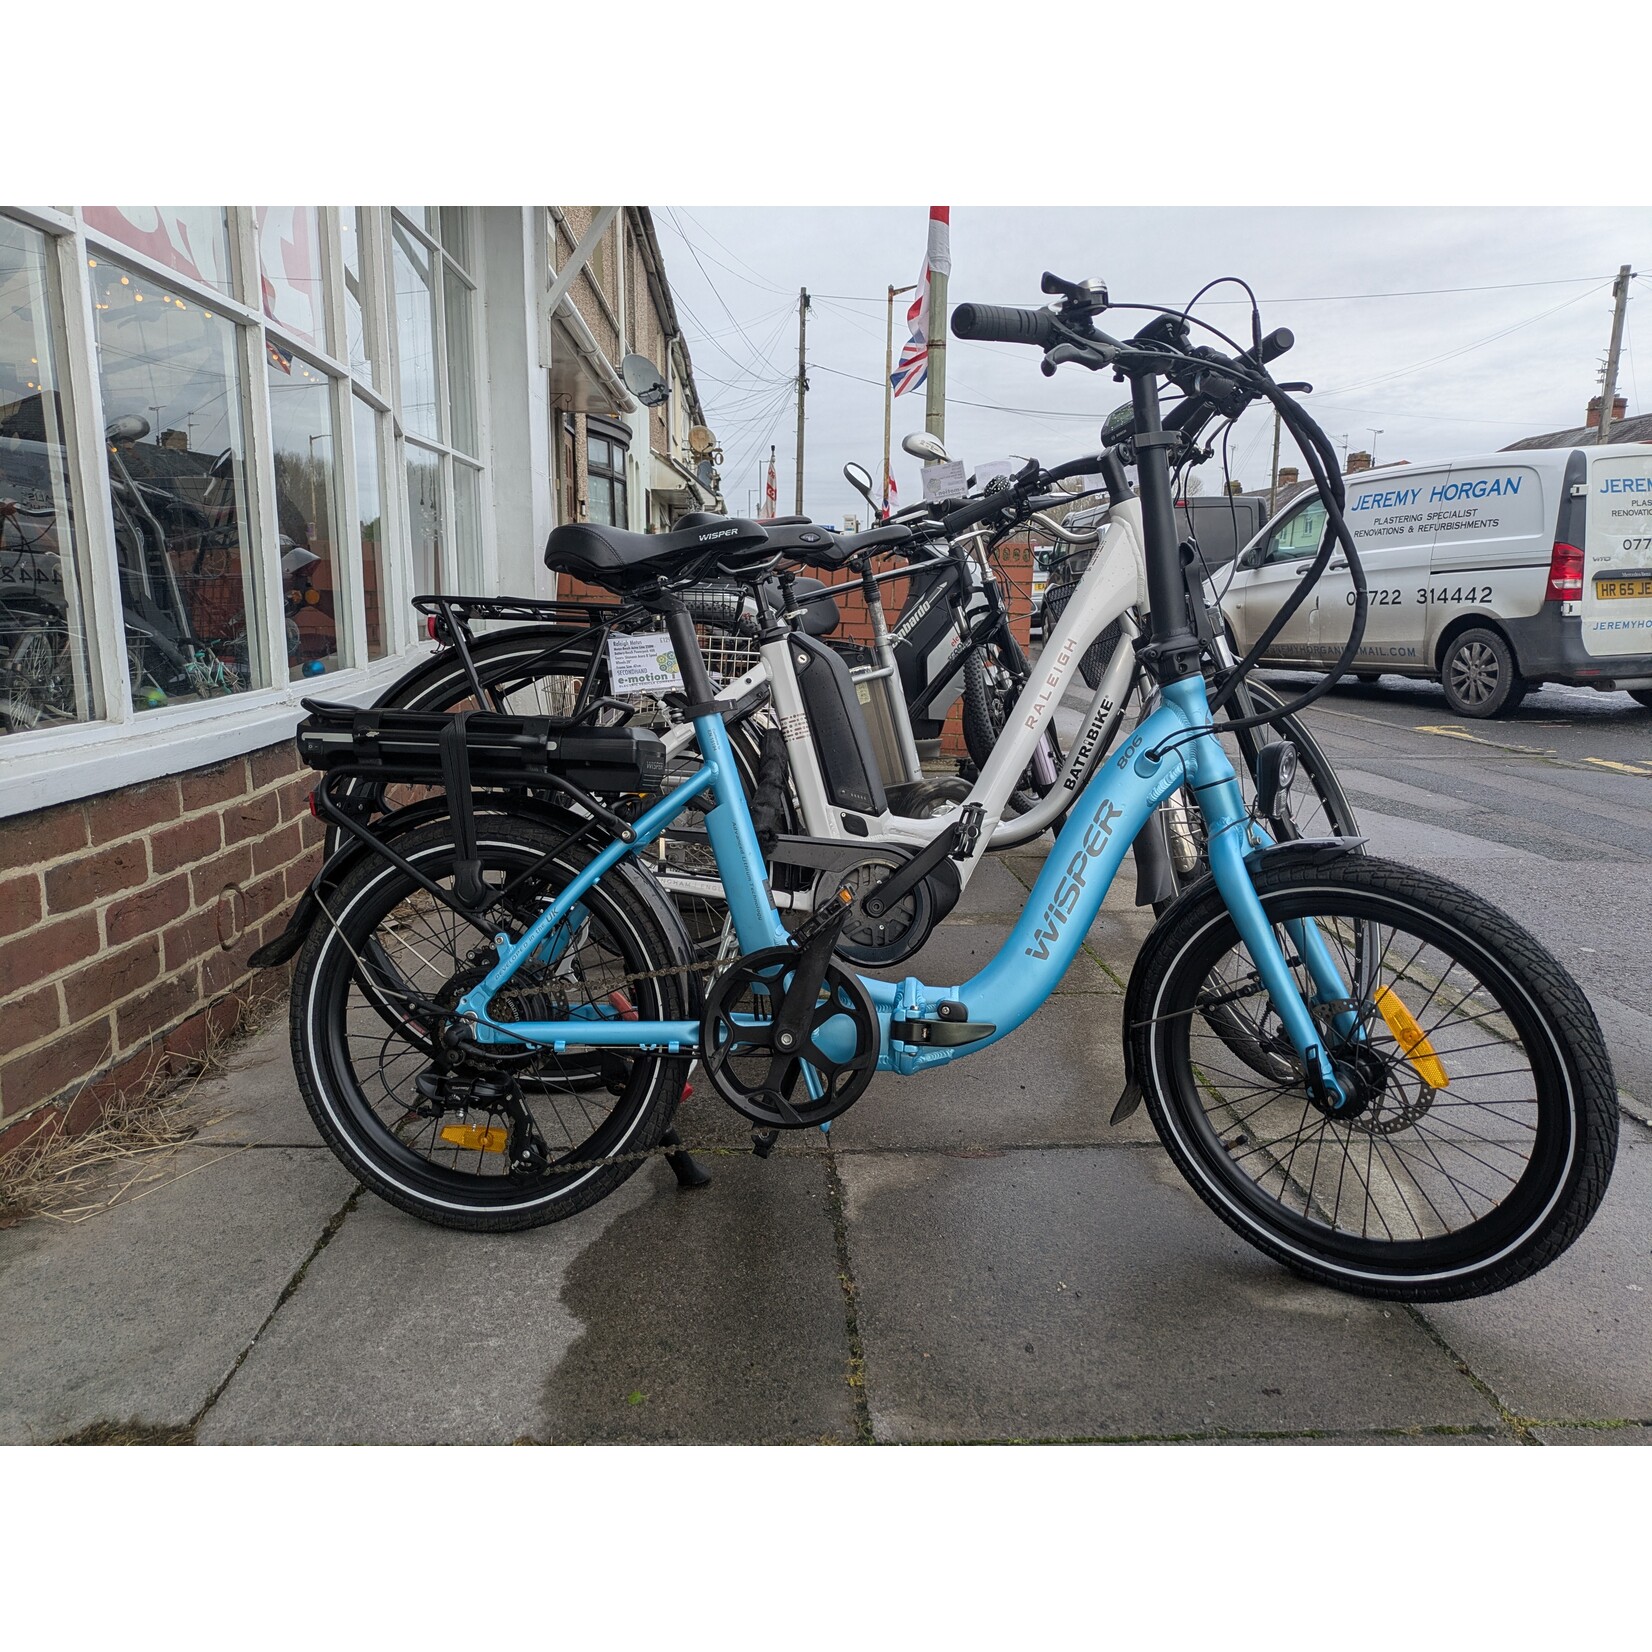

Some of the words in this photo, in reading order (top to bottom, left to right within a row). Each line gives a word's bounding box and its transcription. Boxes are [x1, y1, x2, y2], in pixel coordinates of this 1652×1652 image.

[1351, 487, 1422, 511] JEREMY
[1429, 475, 1522, 502] HORGAN
[1353, 525, 1405, 538] RENOVATIONS
[1407, 525, 1414, 533] &
[1417, 518, 1500, 533] REFURBISHMENTS
[1374, 514, 1423, 526] PLASTERING
[1426, 508, 1478, 521] SPECIALIST
[698, 527, 739, 542] WISPER
[1623, 538, 1652, 550] 077
[1346, 589, 1402, 606] 0722
[1416, 586, 1493, 605] 314442
[1601, 584, 1616, 597] HR
[1619, 583, 1635, 596] 65
[892, 600, 931, 649] mbardo
[617, 668, 648, 676] SECONDHAND
[1025, 638, 1078, 730] RALEIGH
[1116, 734, 1143, 770] 806
[732, 821, 746, 852] Advanced
[749, 881, 763, 921] Technology
[1025, 798, 1123, 961] WISPER
[495, 942, 529, 980] DEVELOPED
[529, 934, 535, 942] in
[535, 923, 546, 935] the
[546, 907, 560, 923] UK
